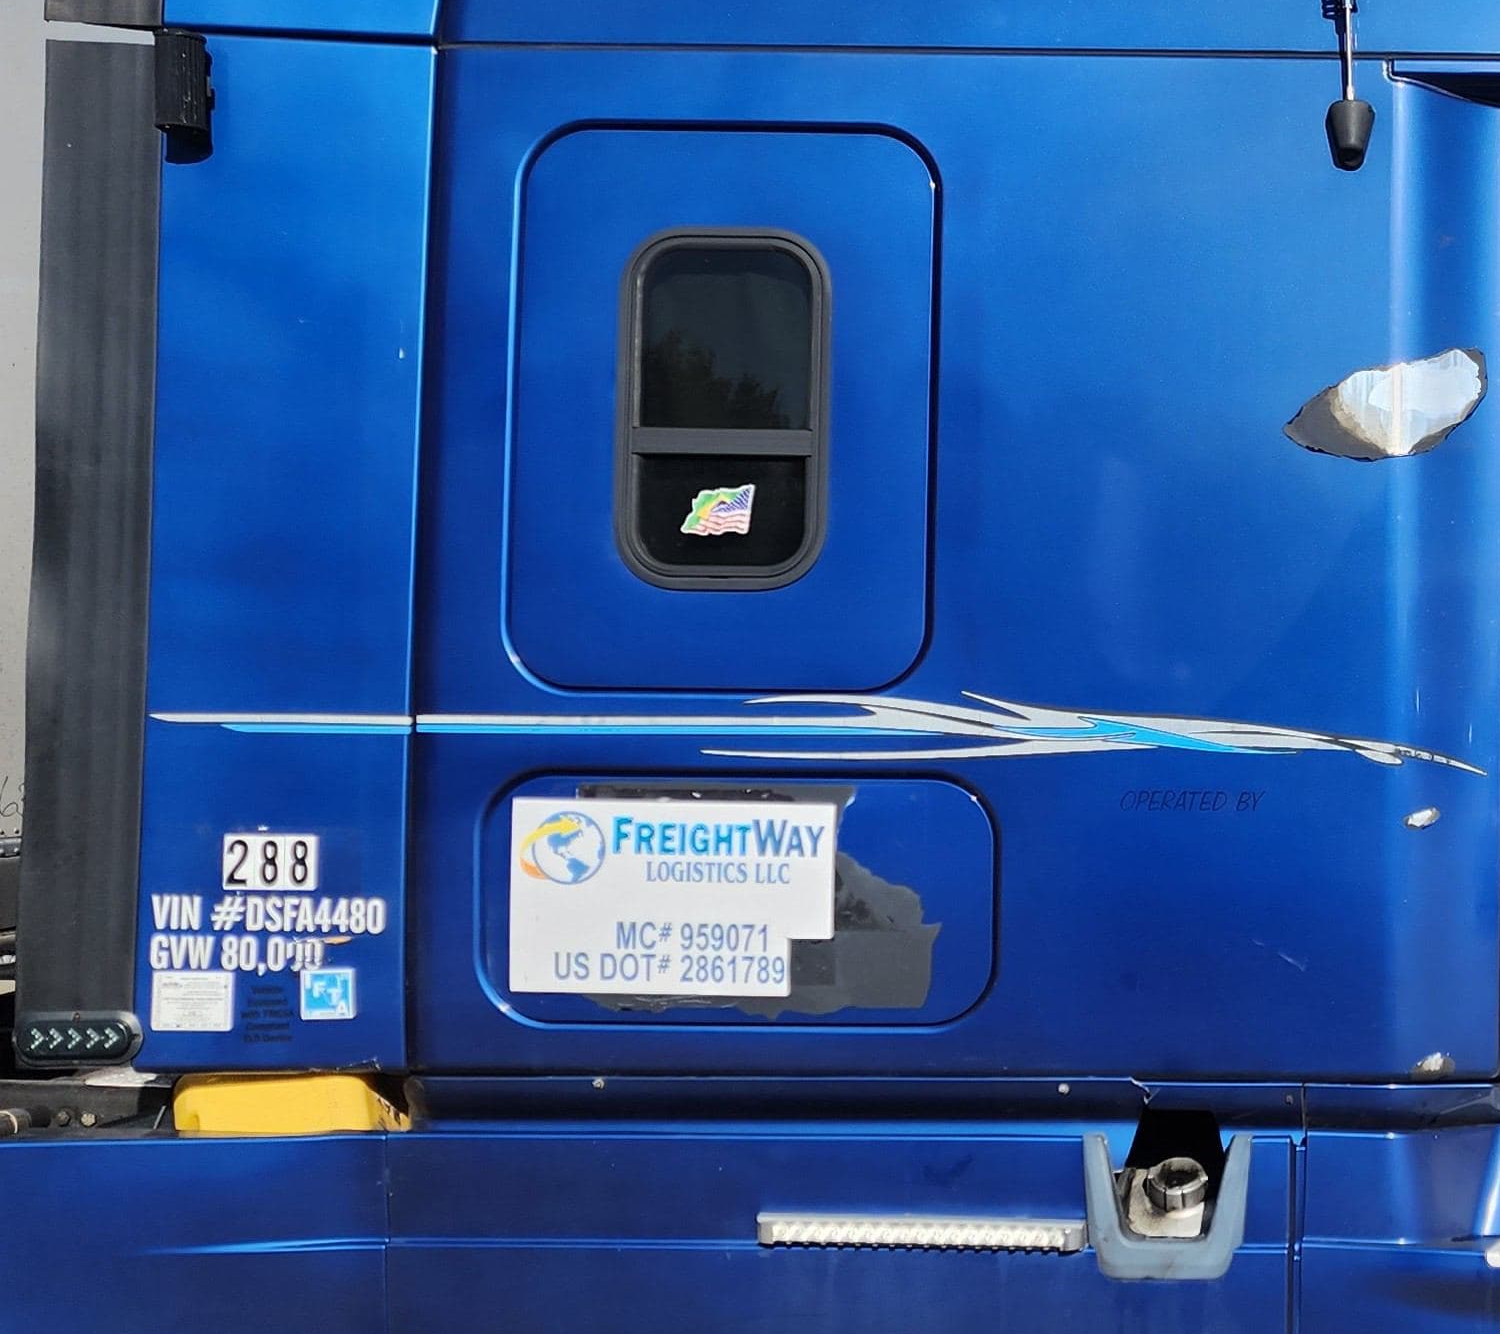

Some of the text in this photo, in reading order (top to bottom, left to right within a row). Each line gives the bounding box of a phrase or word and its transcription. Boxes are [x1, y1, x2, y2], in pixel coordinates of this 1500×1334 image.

[1120, 790, 1266, 811] OPERATED BY
[225, 839, 308, 886] 288
[647, 861, 790, 884] LOGISTICS LLC
[151, 894, 387, 934] VIN #DSFA4480
[150, 933, 215, 970] GVW
[616, 921, 769, 952] MC# 959071
[554, 951, 785, 984] US DOT# 2861789
